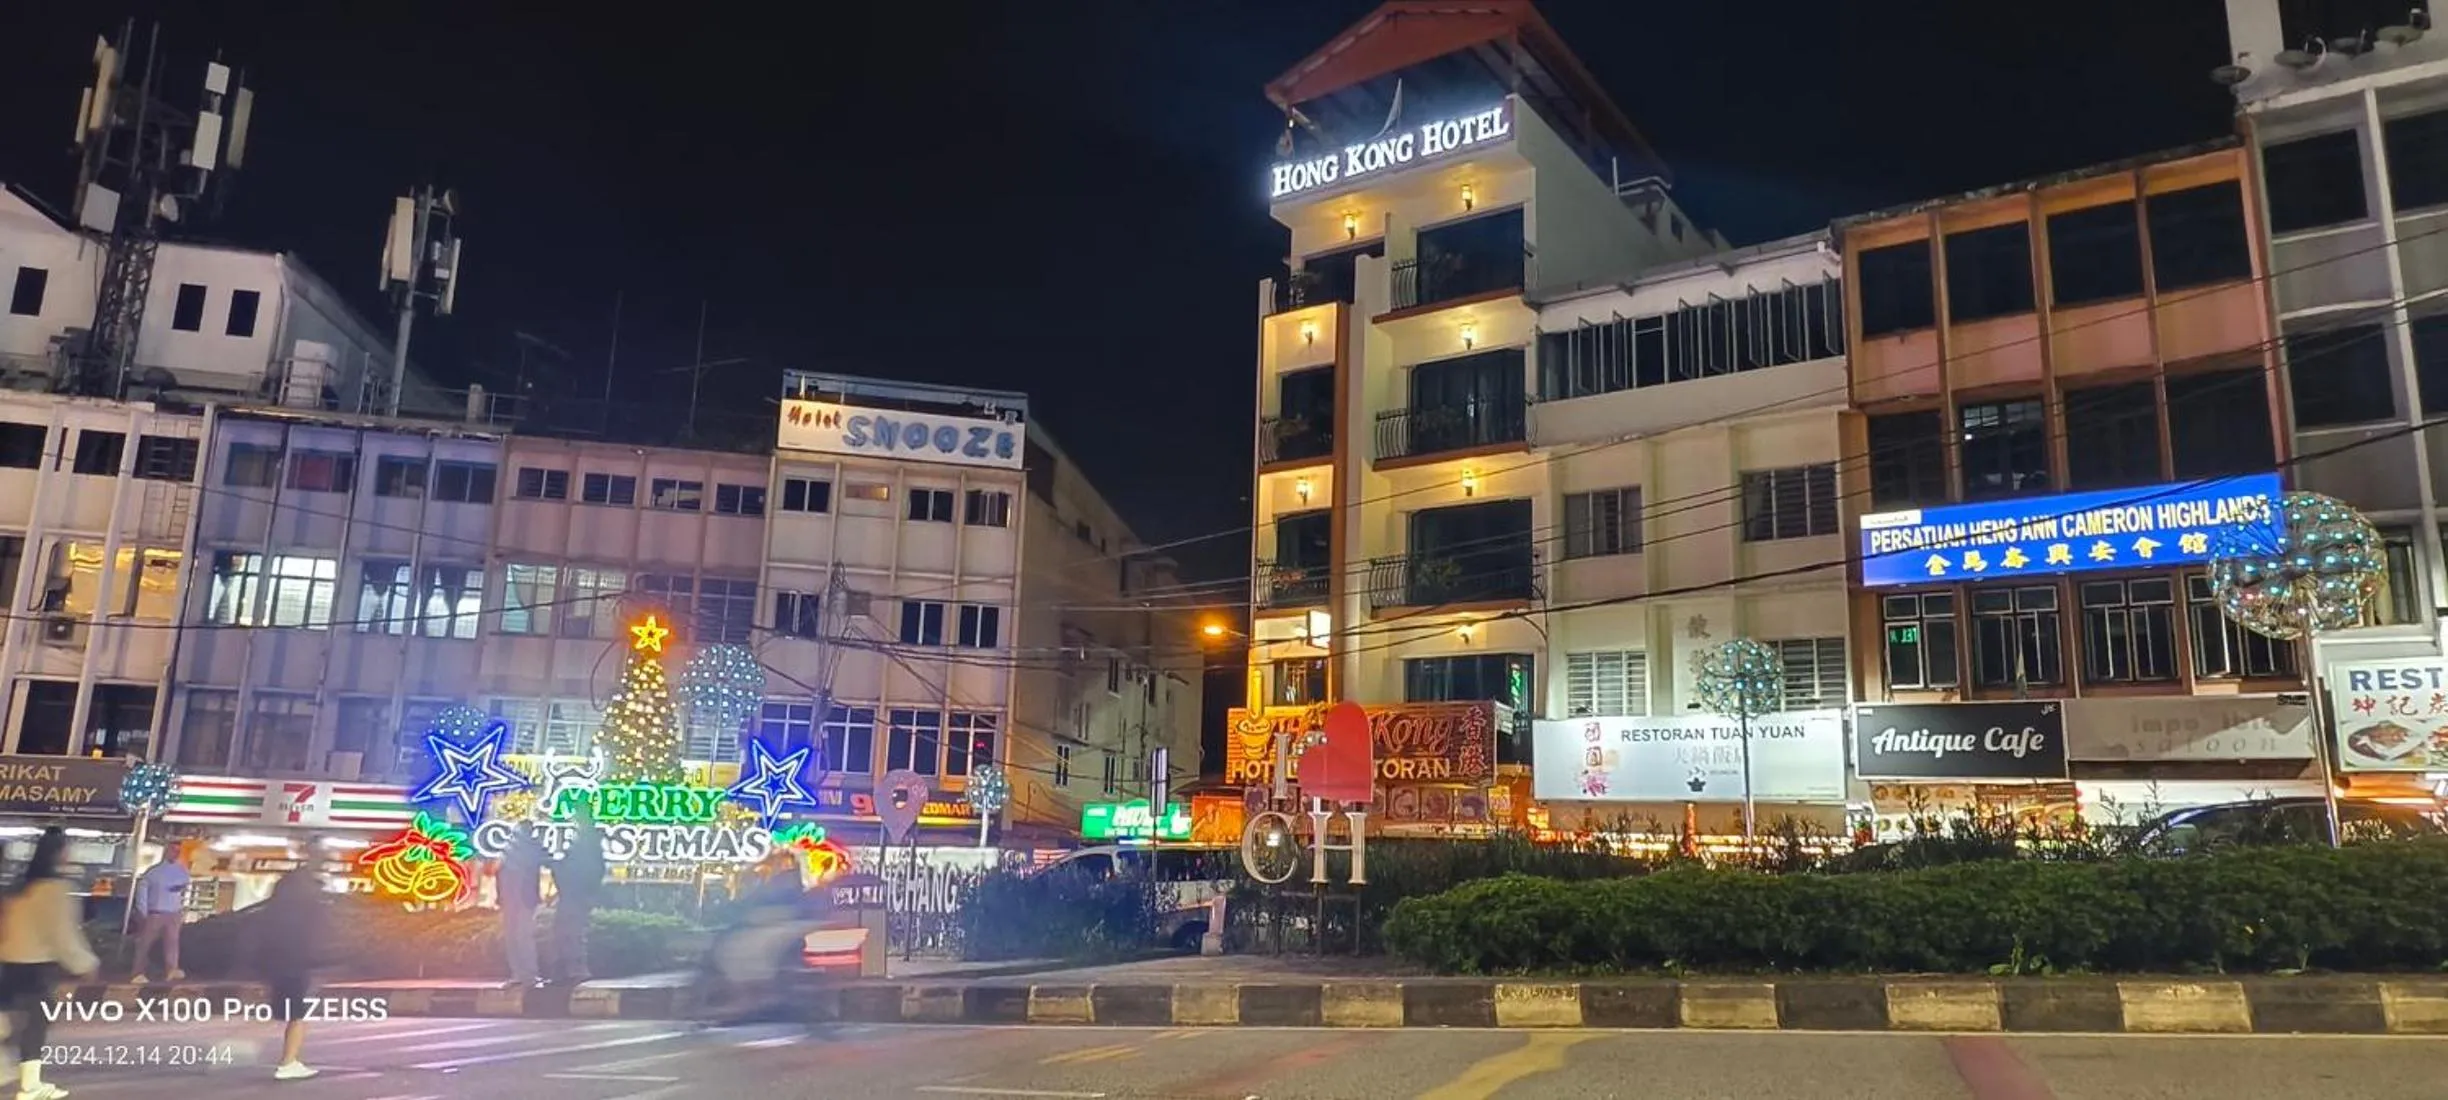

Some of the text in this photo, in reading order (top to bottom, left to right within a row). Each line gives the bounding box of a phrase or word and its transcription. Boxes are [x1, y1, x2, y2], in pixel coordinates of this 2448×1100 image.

[1271, 106, 1510, 197] HONG KONG HOTEL
[787, 405, 1016, 460] Hotel SNOOZE
[1870, 493, 2271, 554] PERSATUAN HENG ANN CAMERON HIGHLANDS
[2349, 667, 2444, 692] REST
[1621, 725, 1805, 742] RESTORAN TUAN YUAN
[1871, 727, 2045, 758] Antique Cafe
